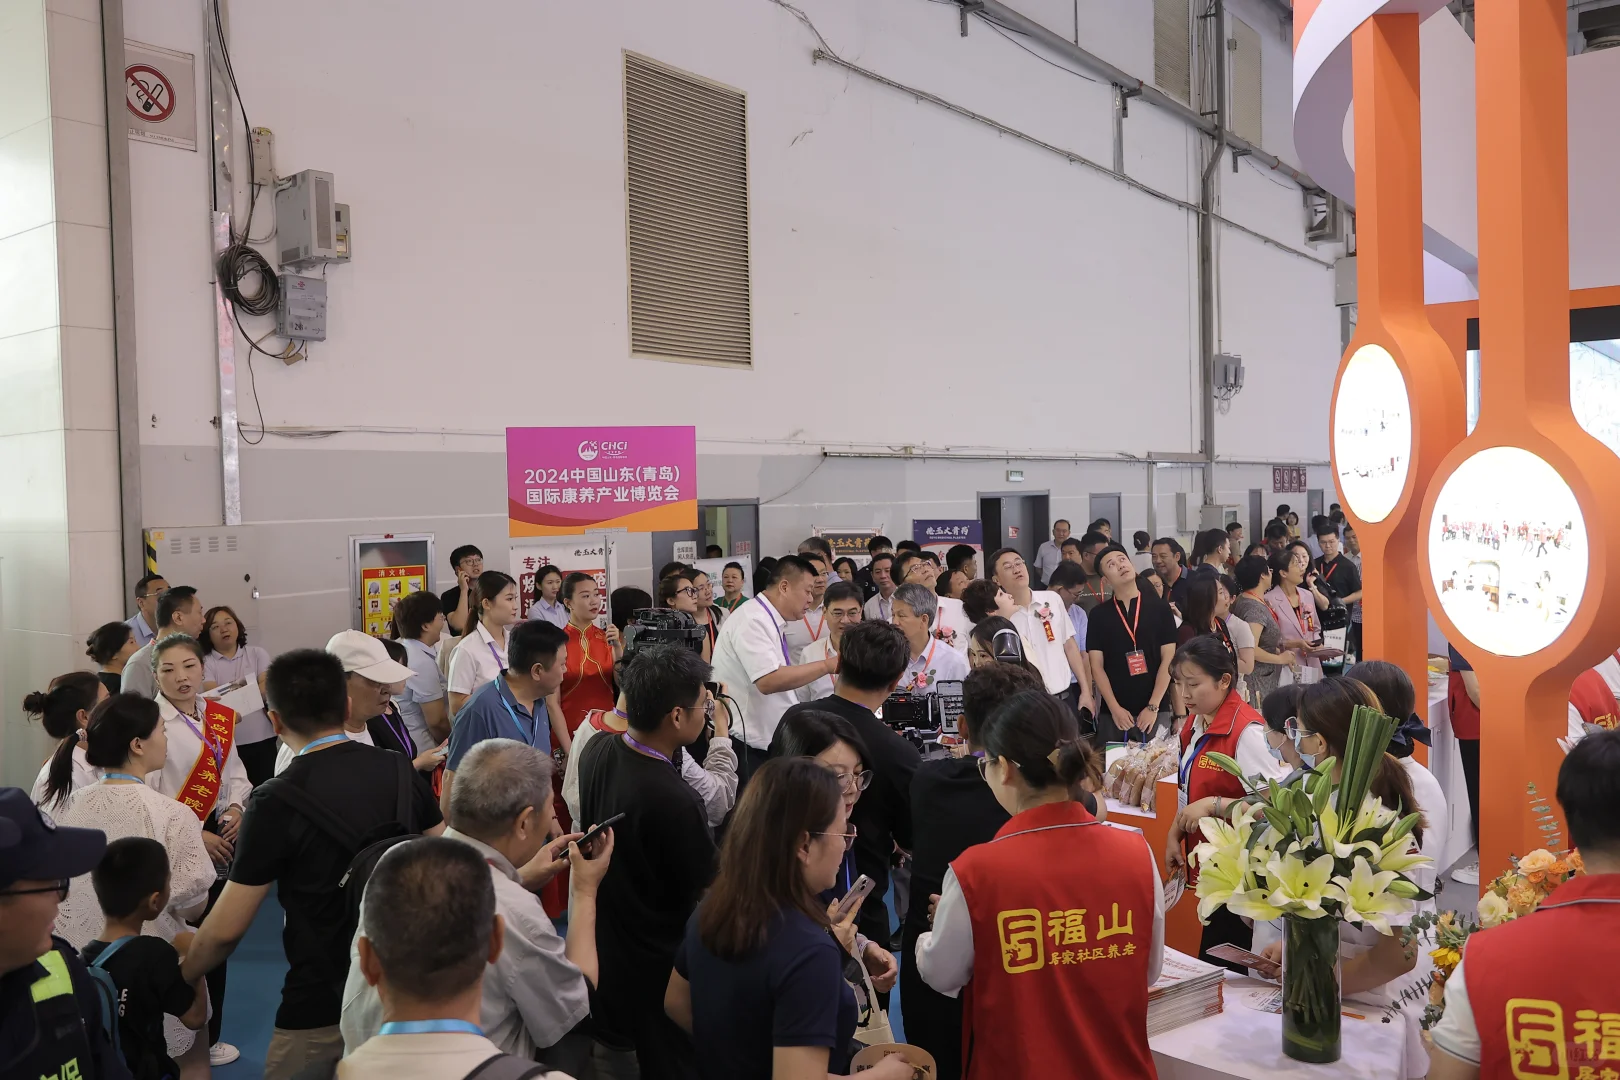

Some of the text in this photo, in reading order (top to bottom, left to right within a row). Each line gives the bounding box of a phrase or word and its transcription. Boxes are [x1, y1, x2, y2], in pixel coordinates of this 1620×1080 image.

[524, 466, 680, 484] 2024中国山东(青岛)
[526, 485, 680, 505] 国际康养产业博览会
[378, 568, 406, 578] 消火栓
[523, 556, 550, 570] 专注
[184, 712, 230, 812] 青岛市养老院
[1048, 902, 1133, 946] 福山
[1048, 942, 1137, 966] 居家社区养老
